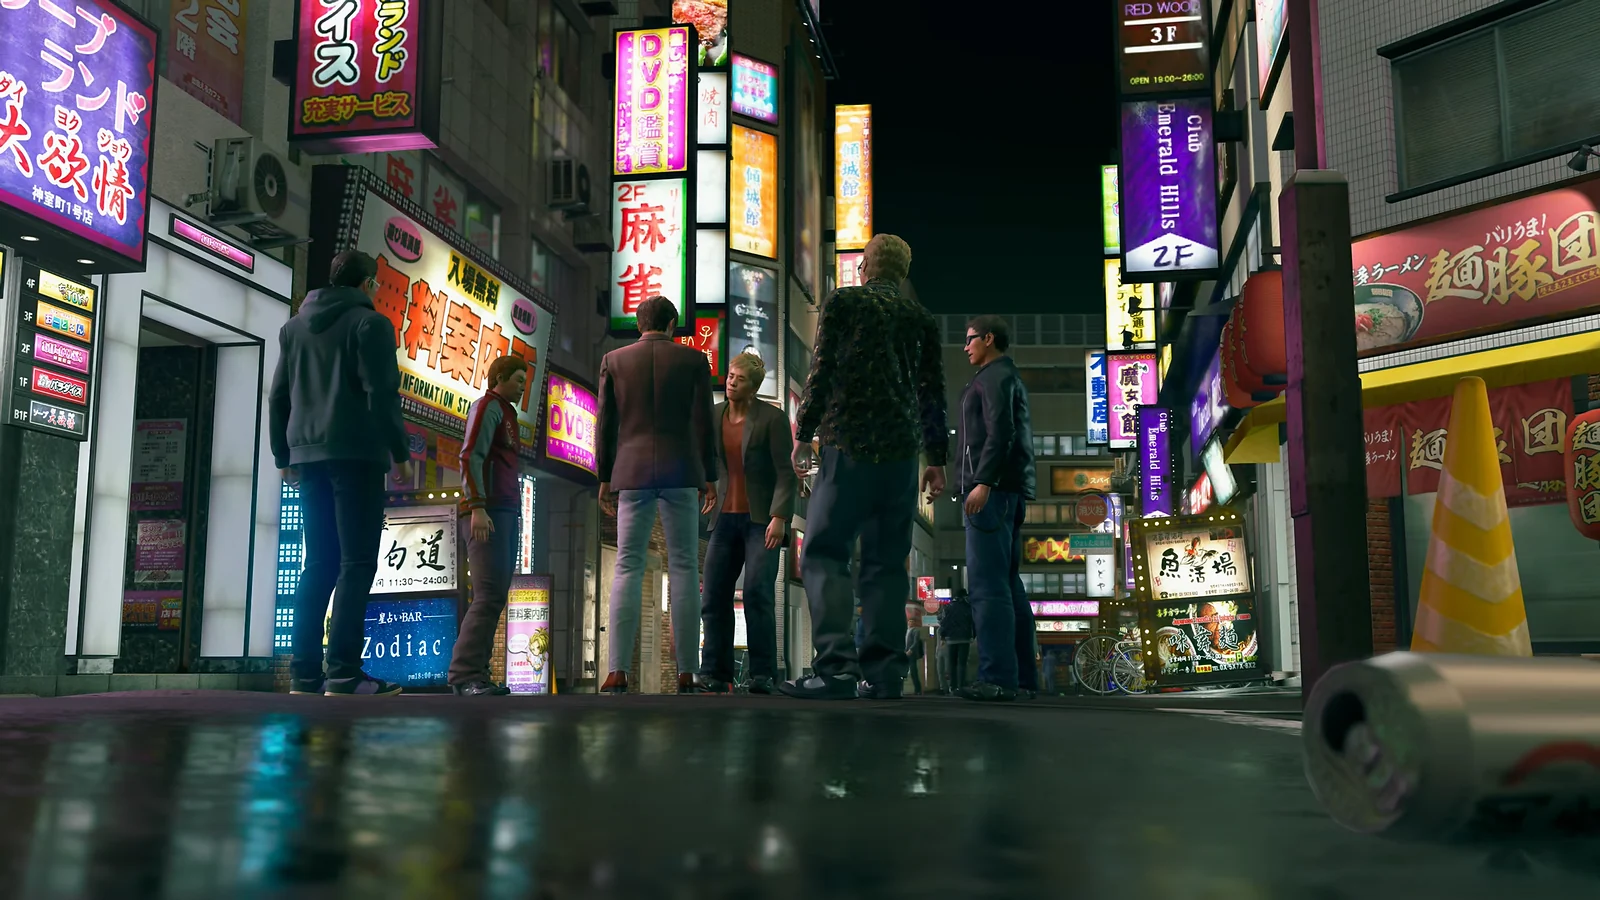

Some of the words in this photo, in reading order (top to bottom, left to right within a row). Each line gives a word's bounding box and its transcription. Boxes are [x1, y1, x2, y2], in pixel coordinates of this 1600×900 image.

[1124, 3, 1153, 17] RED
[1150, 26, 1177, 44] 3F
[41, 38, 146, 133] ランド
[1130, 77, 1150, 85] OPEN
[302, 92, 412, 125] 充実サービス
[701, 87, 721, 128] 焼肉
[1157, 103, 1178, 176] Emerald
[1187, 114, 1202, 153] Club
[617, 184, 647, 202] 2F
[31, 184, 94, 227] 神室町1号店
[1160, 184, 1180, 230] Hills
[1485, 213, 1547, 245] バリうま!
[617, 203, 666, 315] 麻雀
[1153, 243, 1194, 268] 2F
[447, 254, 500, 311] 入場無料
[1352, 254, 1428, 287] 多ラーメン
[26, 278, 36, 289] 4F
[23, 311, 33, 322] 3F
[21, 343, 31, 354] 2F
[19, 377, 28, 388] 1F
[14, 408, 28, 421] B1F
[1159, 412, 1168, 433] Club
[1148, 427, 1161, 471] Emerald
[1078, 505, 1105, 516] 消火栓
[1095, 557, 1106, 591] かどや
[378, 612, 422, 625] 星占いBAR
[508, 607, 549, 621] 無料案内所
[361, 635, 442, 659] Zodiac
